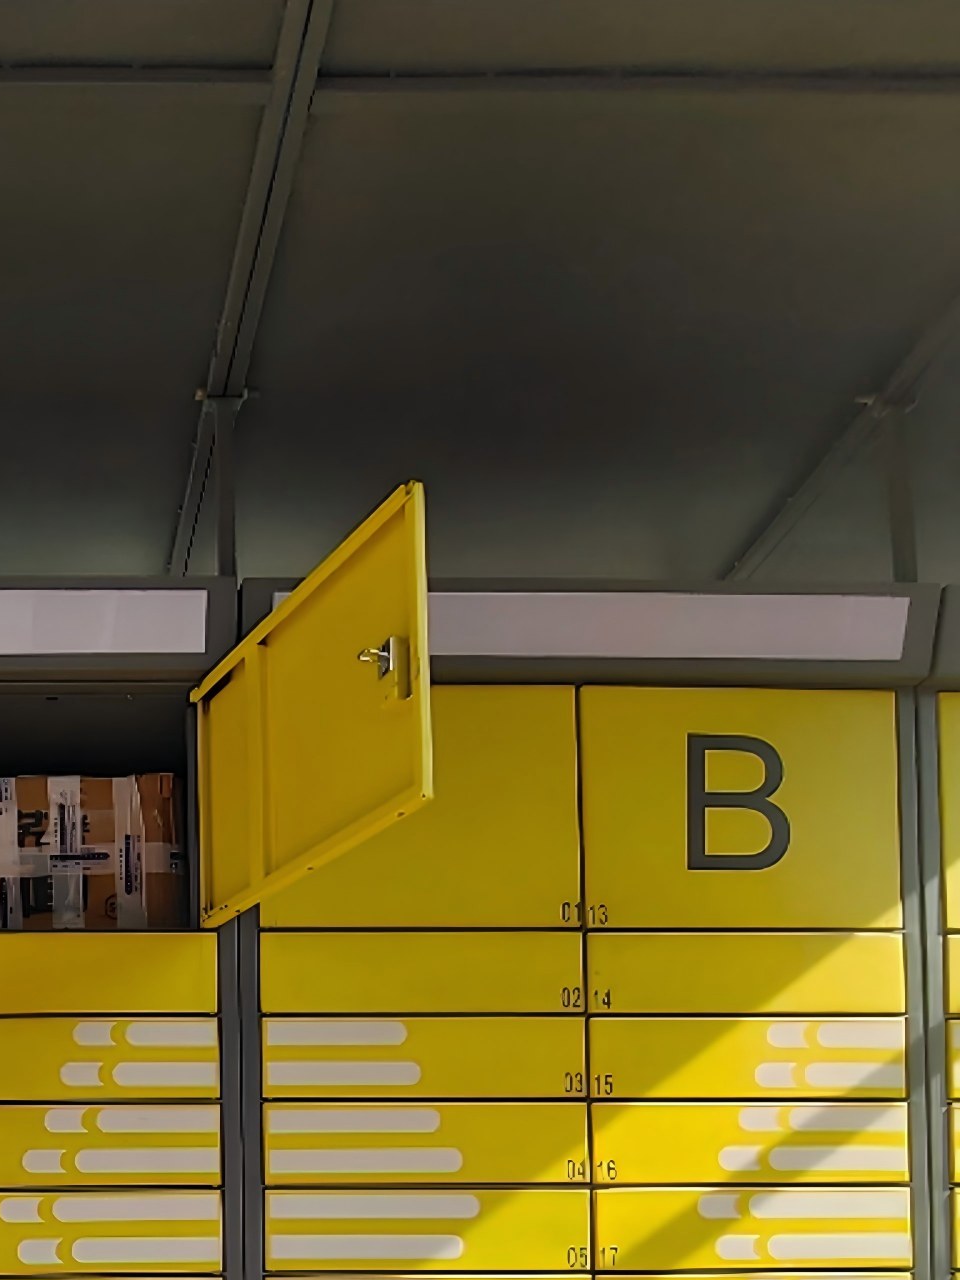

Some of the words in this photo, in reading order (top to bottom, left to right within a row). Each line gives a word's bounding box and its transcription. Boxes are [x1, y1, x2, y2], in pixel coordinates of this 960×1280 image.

[687, 733, 790, 870] B
[560, 902, 582, 923] 01
[587, 904, 608, 925] 13
[561, 987, 581, 1008] 02
[594, 987, 612, 1009] 14
[565, 1072, 583, 1093] 03
[594, 1074, 613, 1095] 15
[567, 1160, 586, 1180] 04
[597, 1160, 617, 1180] 16
[567, 1245, 587, 1267] 05
[601, 1246, 618, 1267] 17
